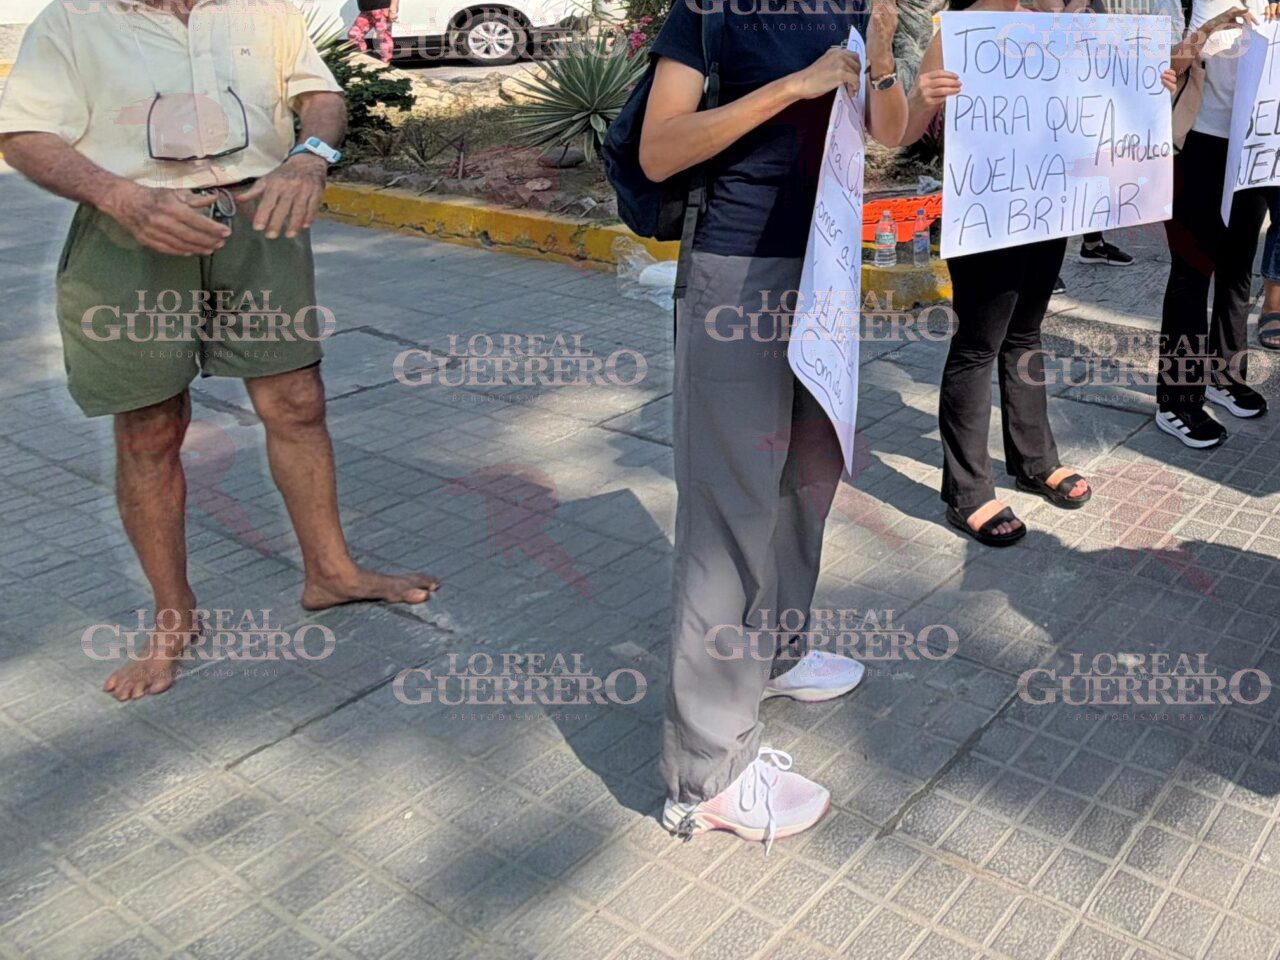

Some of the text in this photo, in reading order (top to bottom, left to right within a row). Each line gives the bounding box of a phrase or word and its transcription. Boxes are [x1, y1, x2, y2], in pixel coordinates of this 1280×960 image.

[954, 26, 1169, 95] TODOS JUNTOS
[955, 94, 1031, 136] PARA
[1045, 94, 1103, 142] QUE
[949, 147, 1067, 197] VUELVA
